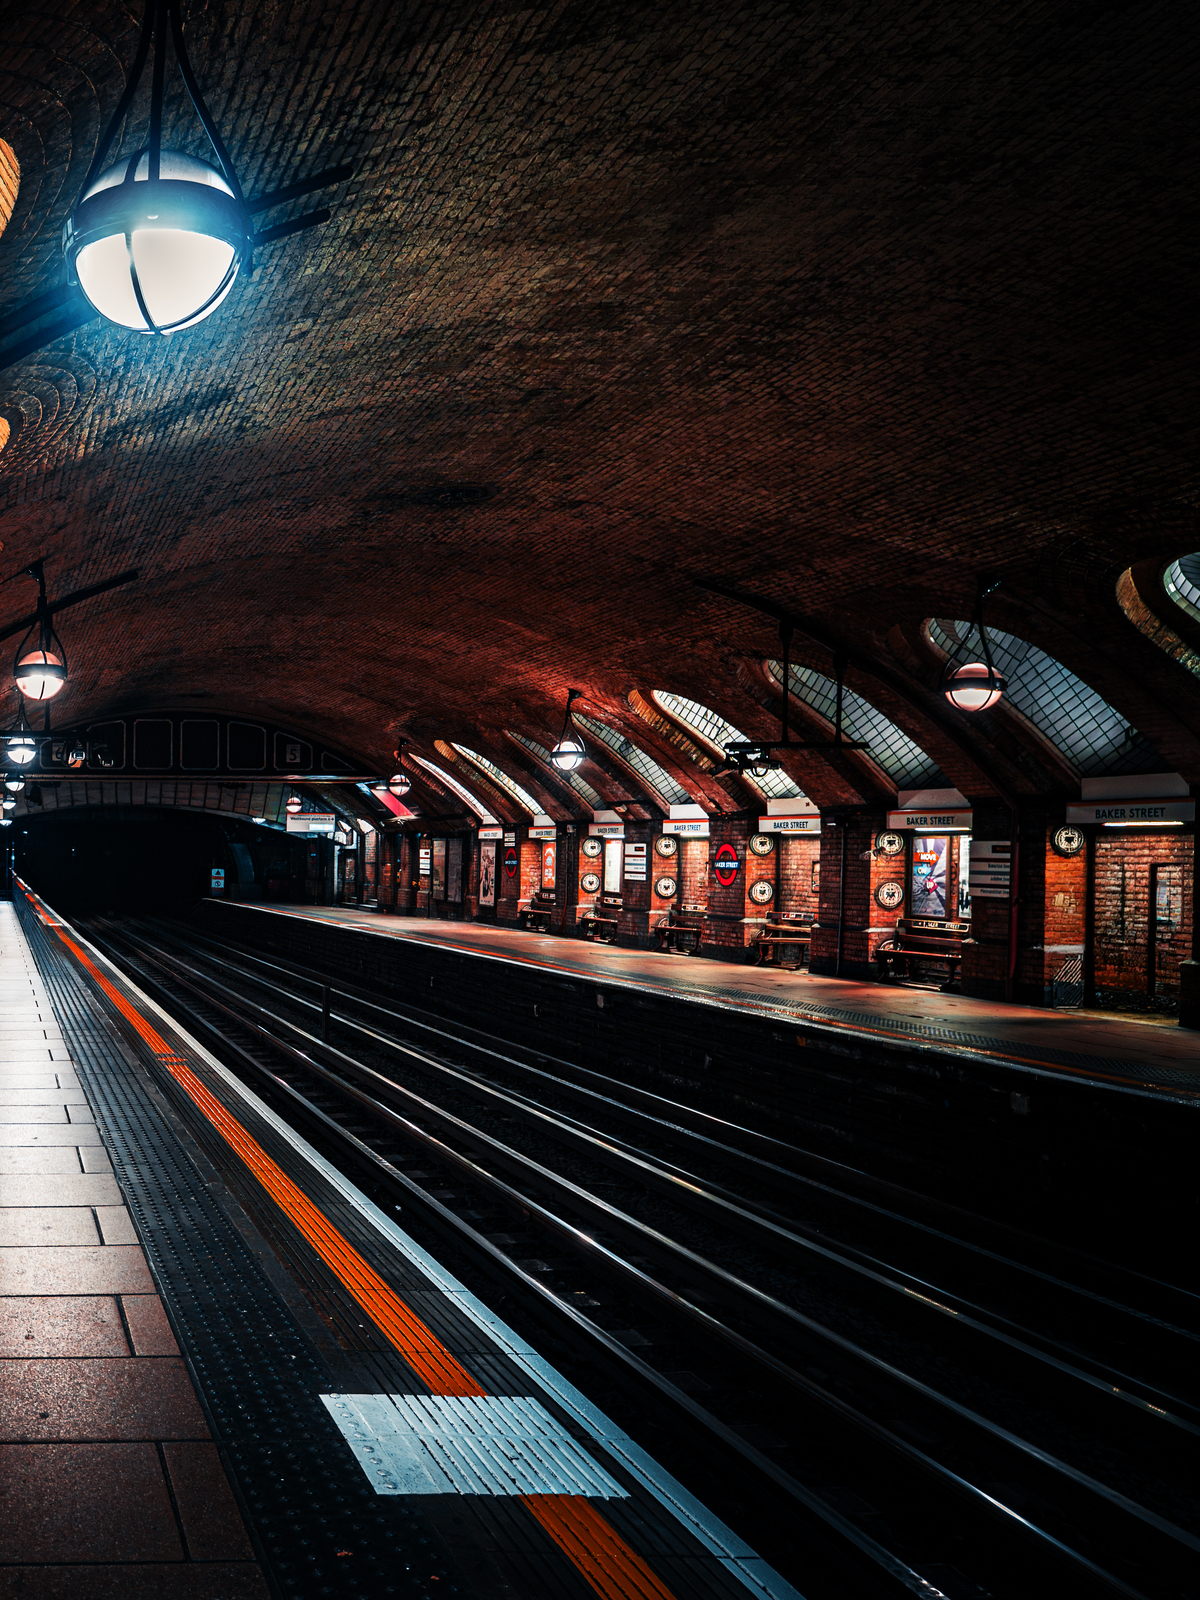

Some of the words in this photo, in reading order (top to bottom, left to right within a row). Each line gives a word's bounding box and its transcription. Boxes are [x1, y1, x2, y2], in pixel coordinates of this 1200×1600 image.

[289, 748, 297, 761] 5
[1095, 808, 1126, 819] BAKER
[1129, 807, 1166, 818] STREET
[906, 817, 928, 825] BAKER
[930, 816, 955, 825] STREET
[920, 853, 937, 861] MOVE
[926, 881, 934, 889] UP
